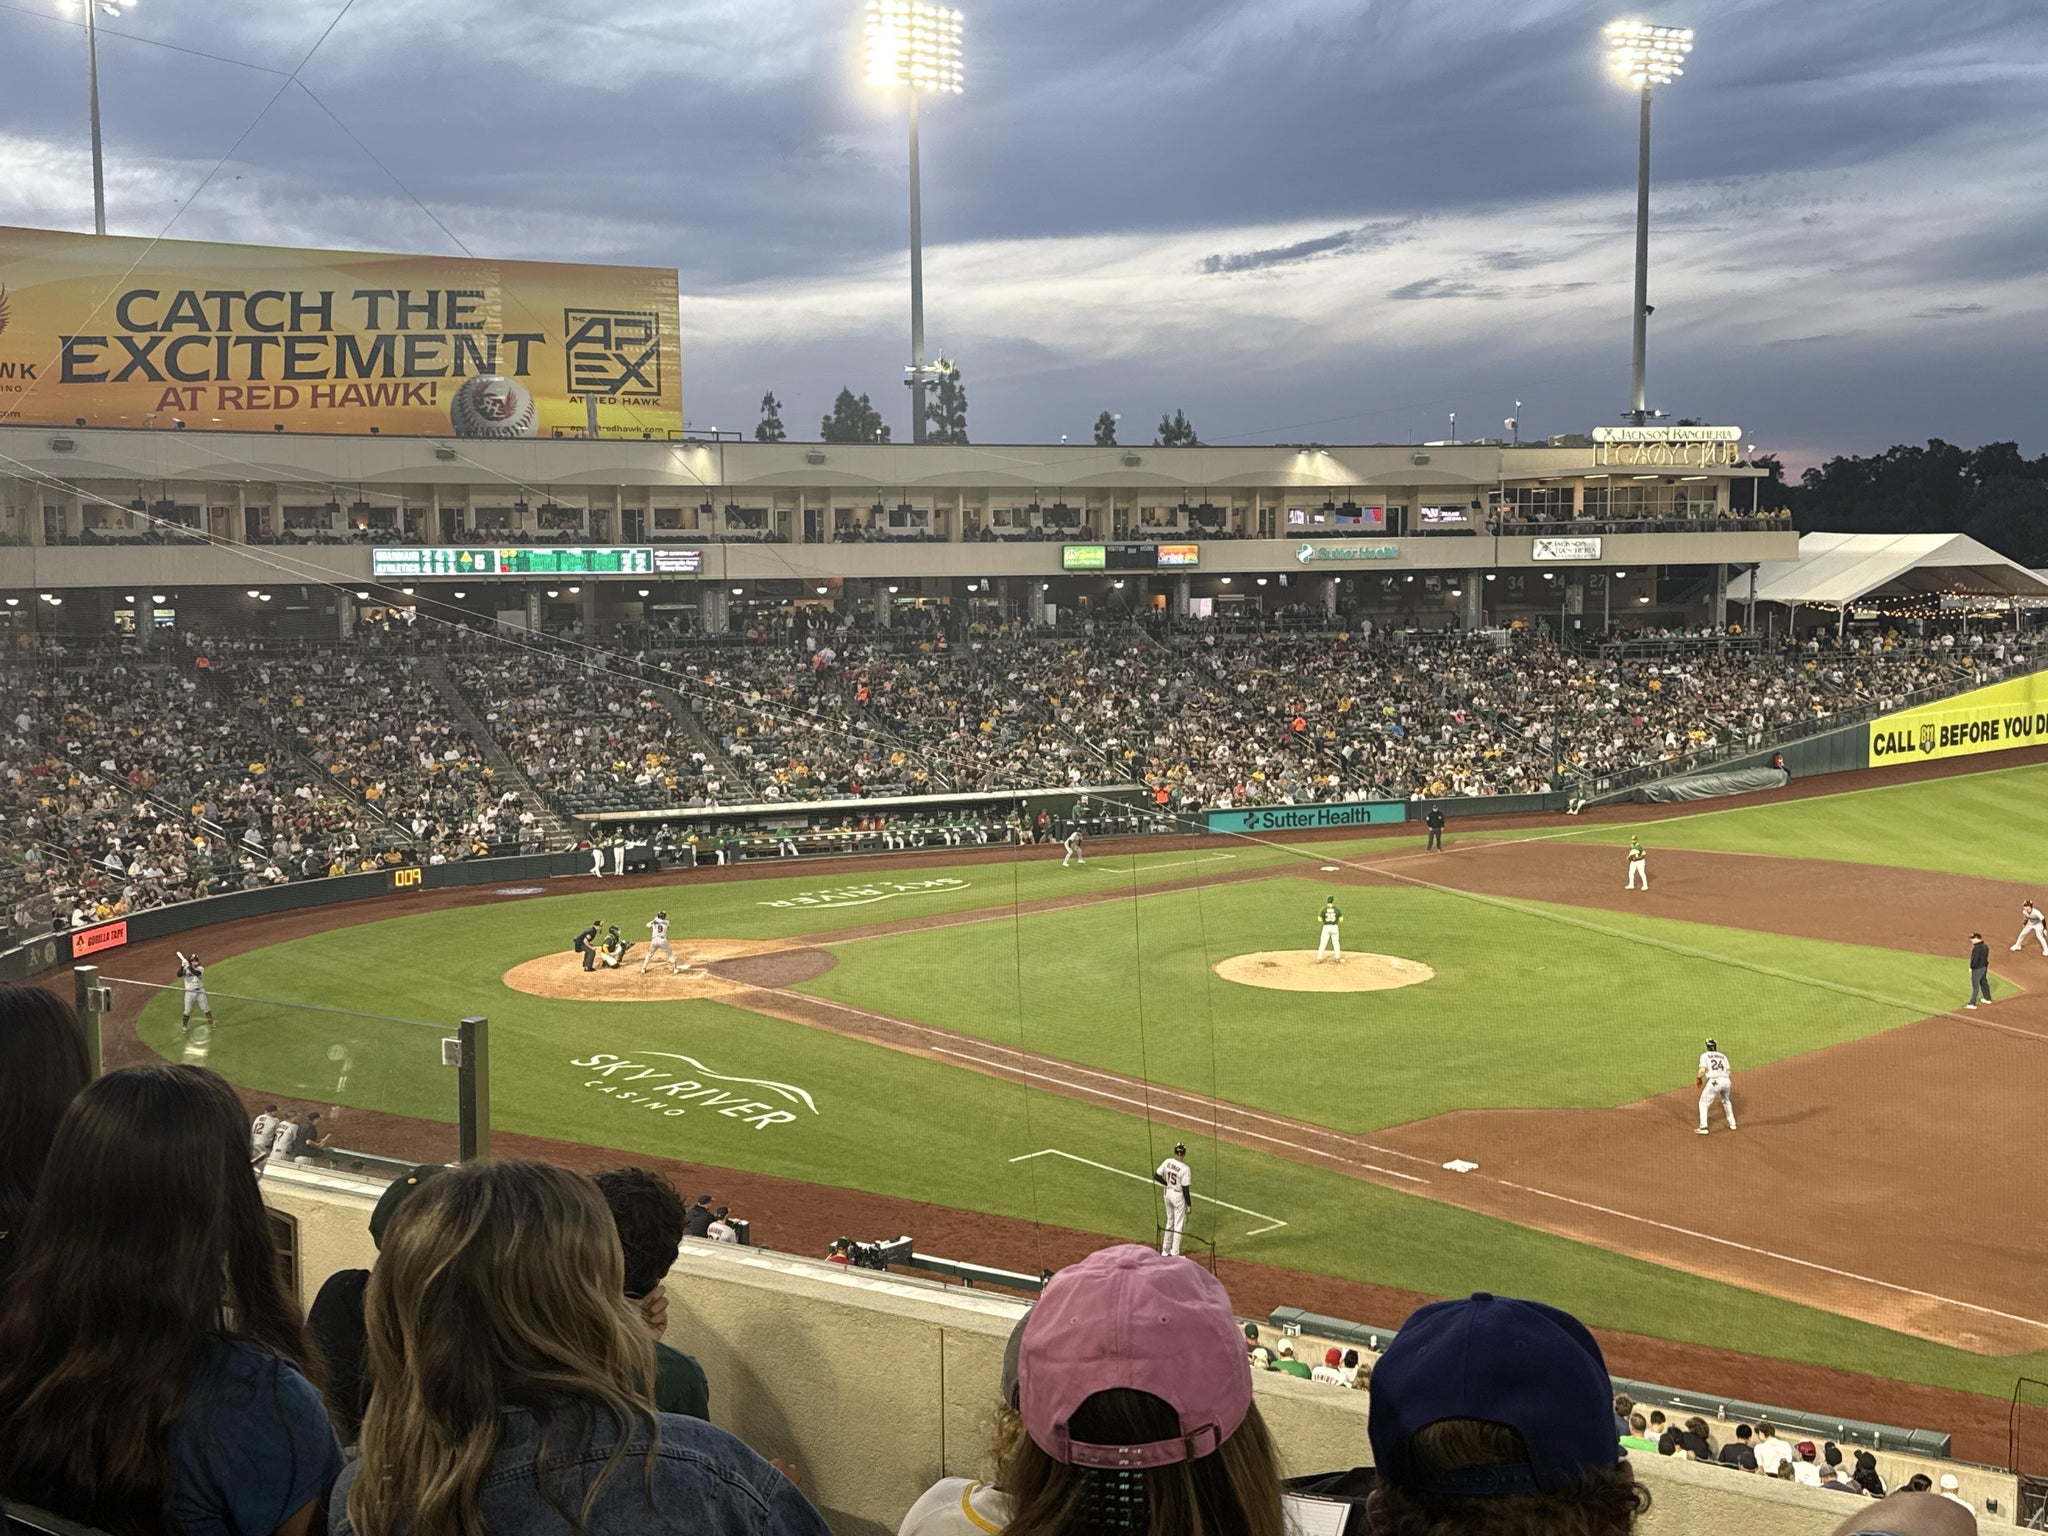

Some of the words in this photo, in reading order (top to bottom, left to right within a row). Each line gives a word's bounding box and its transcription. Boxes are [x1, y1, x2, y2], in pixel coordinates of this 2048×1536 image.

[116, 289, 334, 333] CATCH
[352, 289, 487, 331] THE
[58, 332, 546, 384] EXCITEMENT
[155, 386, 208, 412] AT
[218, 384, 300, 411] RED
[310, 382, 437, 409] HAWK!
[622, 397, 661, 406] HAWK
[1617, 428, 1668, 441] JACKSON
[1673, 429, 1733, 440] RANCHERIA
[1318, 547, 1359, 560] Sutter
[1873, 730, 1916, 756] CALL
[1940, 720, 1999, 747] BEFORE
[2004, 715, 2033, 739] YOU
[1262, 812, 1315, 829] Sutter
[1317, 807, 1371, 826] Health
[657, 924, 663, 933] 9
[1710, 1059, 1725, 1071] 24
[570, 1054, 672, 1081] SKY
[652, 1080, 797, 1130] RIVER
[584, 1080, 686, 1116] CASINO
[253, 1122, 265, 1135] 12
[1167, 1171, 1177, 1186] 15
